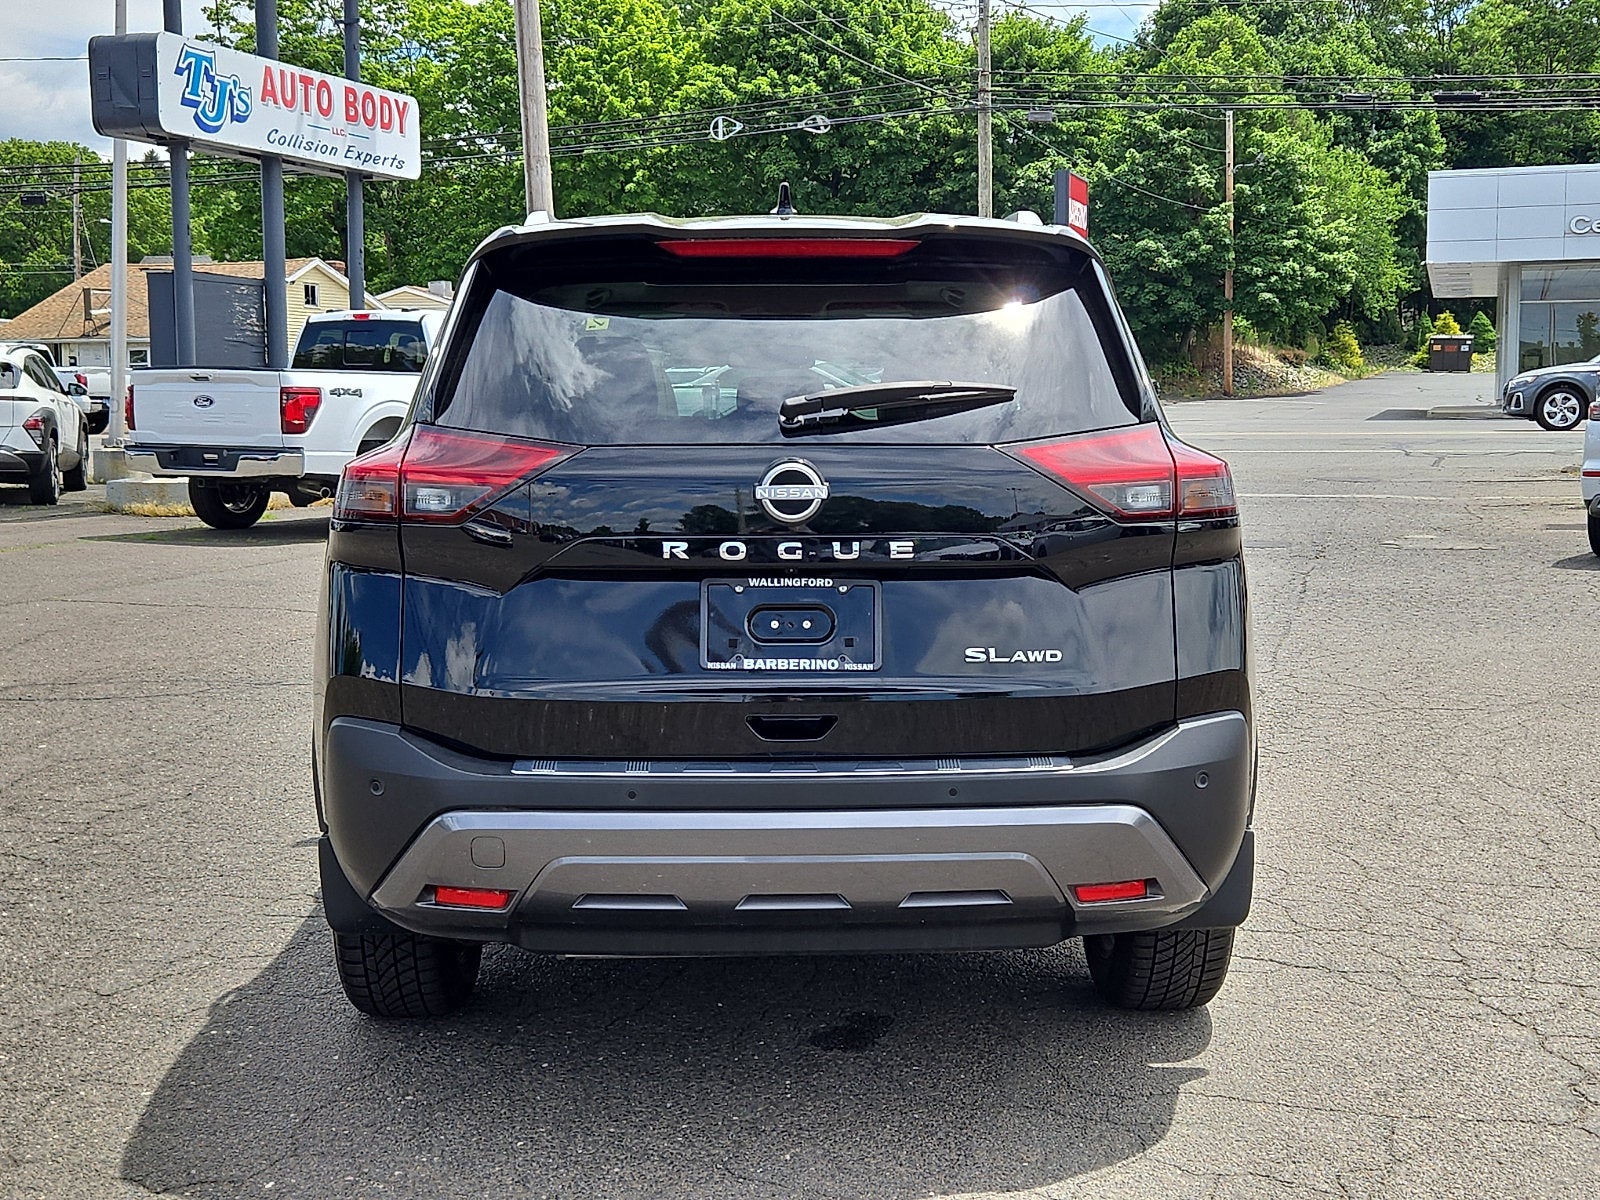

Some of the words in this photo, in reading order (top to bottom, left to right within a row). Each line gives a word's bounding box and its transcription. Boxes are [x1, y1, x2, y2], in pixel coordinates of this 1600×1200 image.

[260, 65, 333, 118] AUTO
[344, 85, 409, 135] BODY
[267, 129, 338, 157] Collision
[344, 145, 406, 170] Experts
[757, 487, 827, 498] NISSAN
[663, 541, 915, 560] ROGUE
[748, 578, 833, 587] WALLINGFORD
[707, 661, 737, 669] NISSAN
[743, 658, 839, 670] BARBERINO
[844, 662, 874, 671] NISSAN
